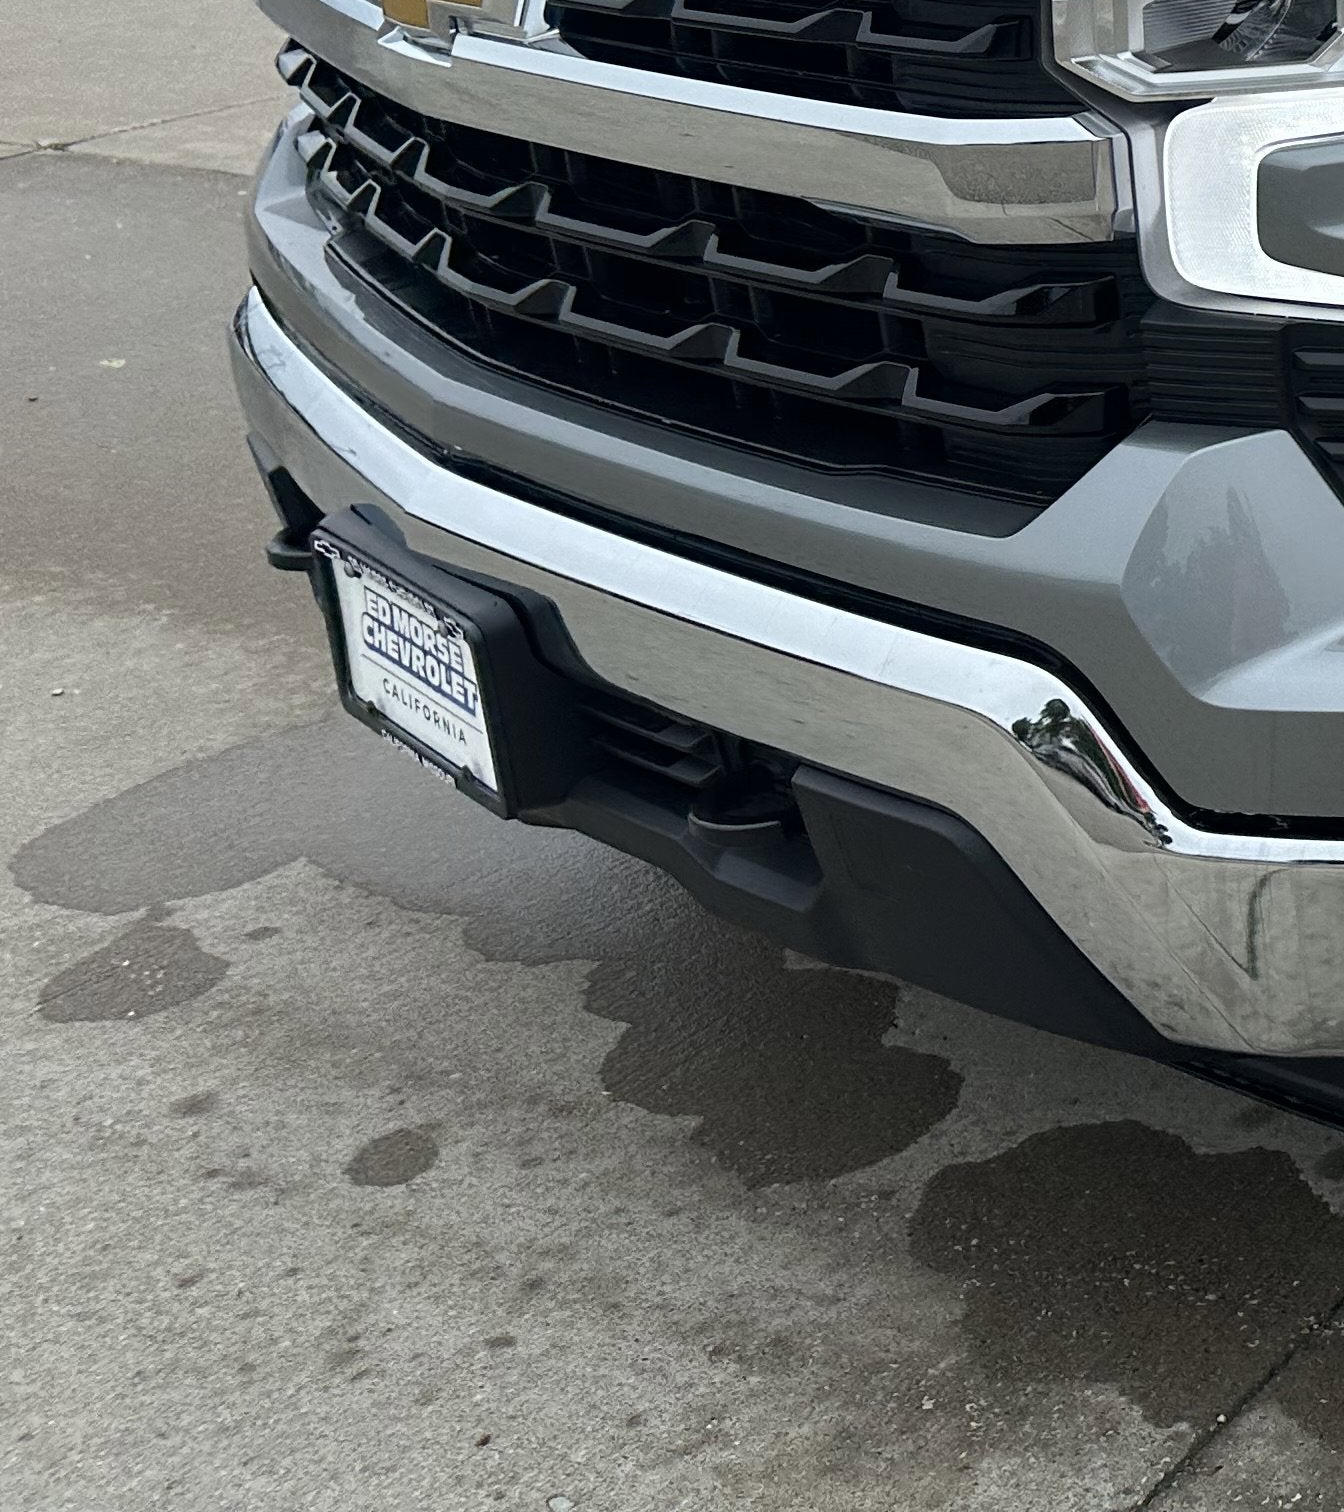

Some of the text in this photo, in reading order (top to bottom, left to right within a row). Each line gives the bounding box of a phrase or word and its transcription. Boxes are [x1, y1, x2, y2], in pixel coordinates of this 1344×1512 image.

[362, 614, 478, 716] CHEVROLET
[364, 586, 391, 627] ED
[392, 605, 464, 673] MORSE
[383, 678, 467, 745] CALIFORNIA
